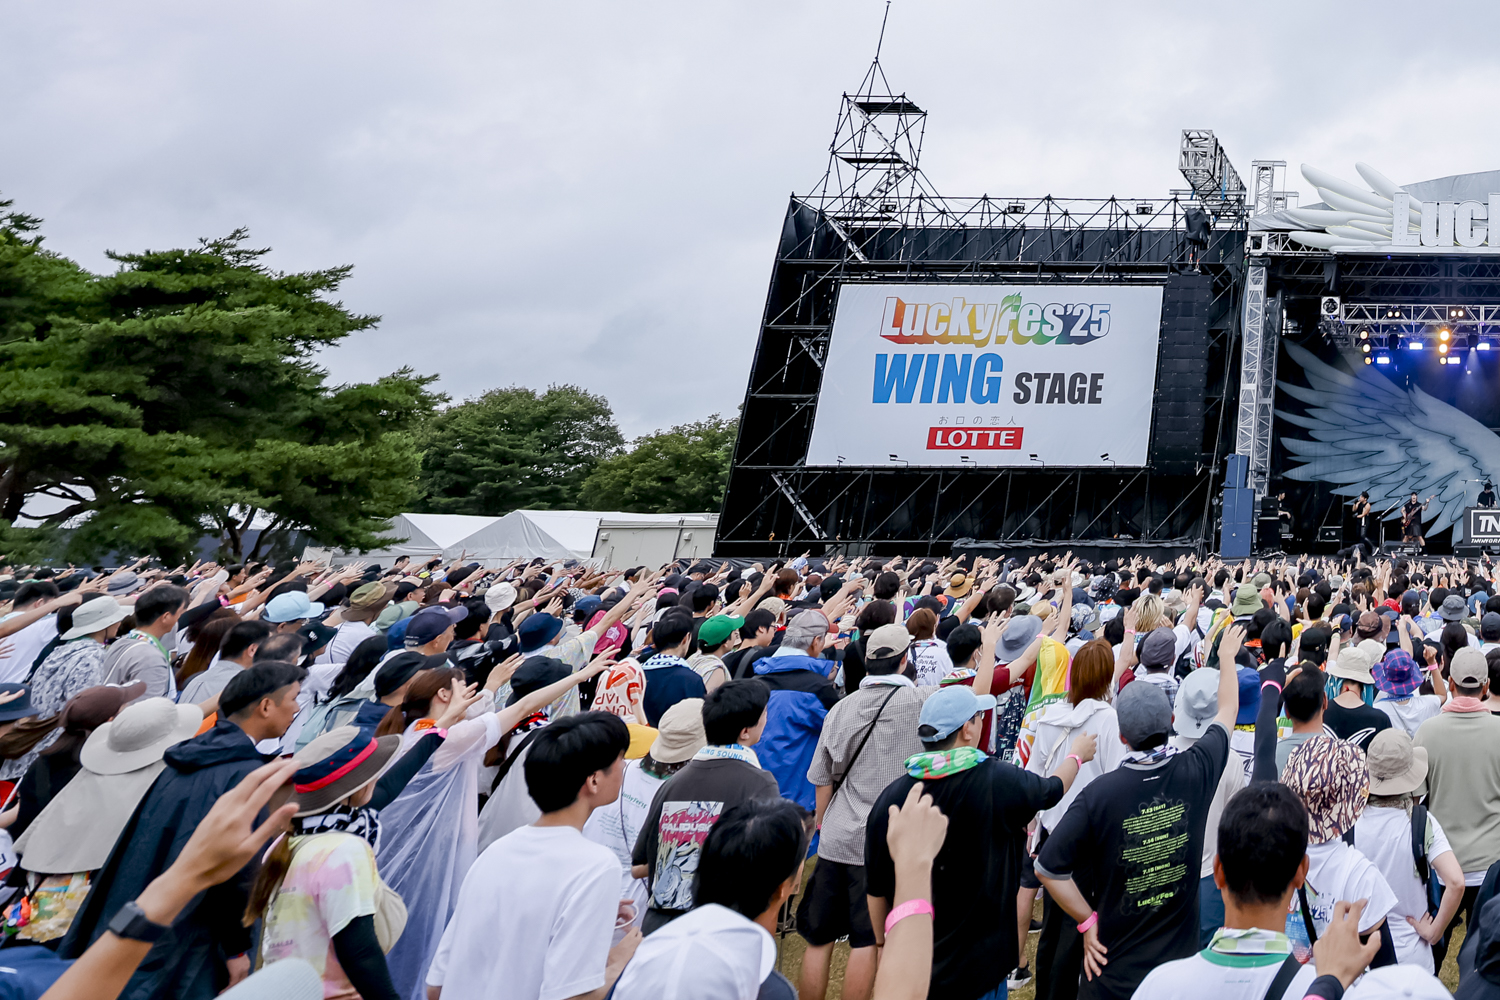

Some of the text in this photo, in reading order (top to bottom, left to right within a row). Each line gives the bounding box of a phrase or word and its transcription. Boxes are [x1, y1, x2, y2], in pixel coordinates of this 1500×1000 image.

[872, 352, 1105, 405] WING STAGE
[938, 415, 1017, 426] お口の恋人
[934, 429, 1017, 448] LOTTE
